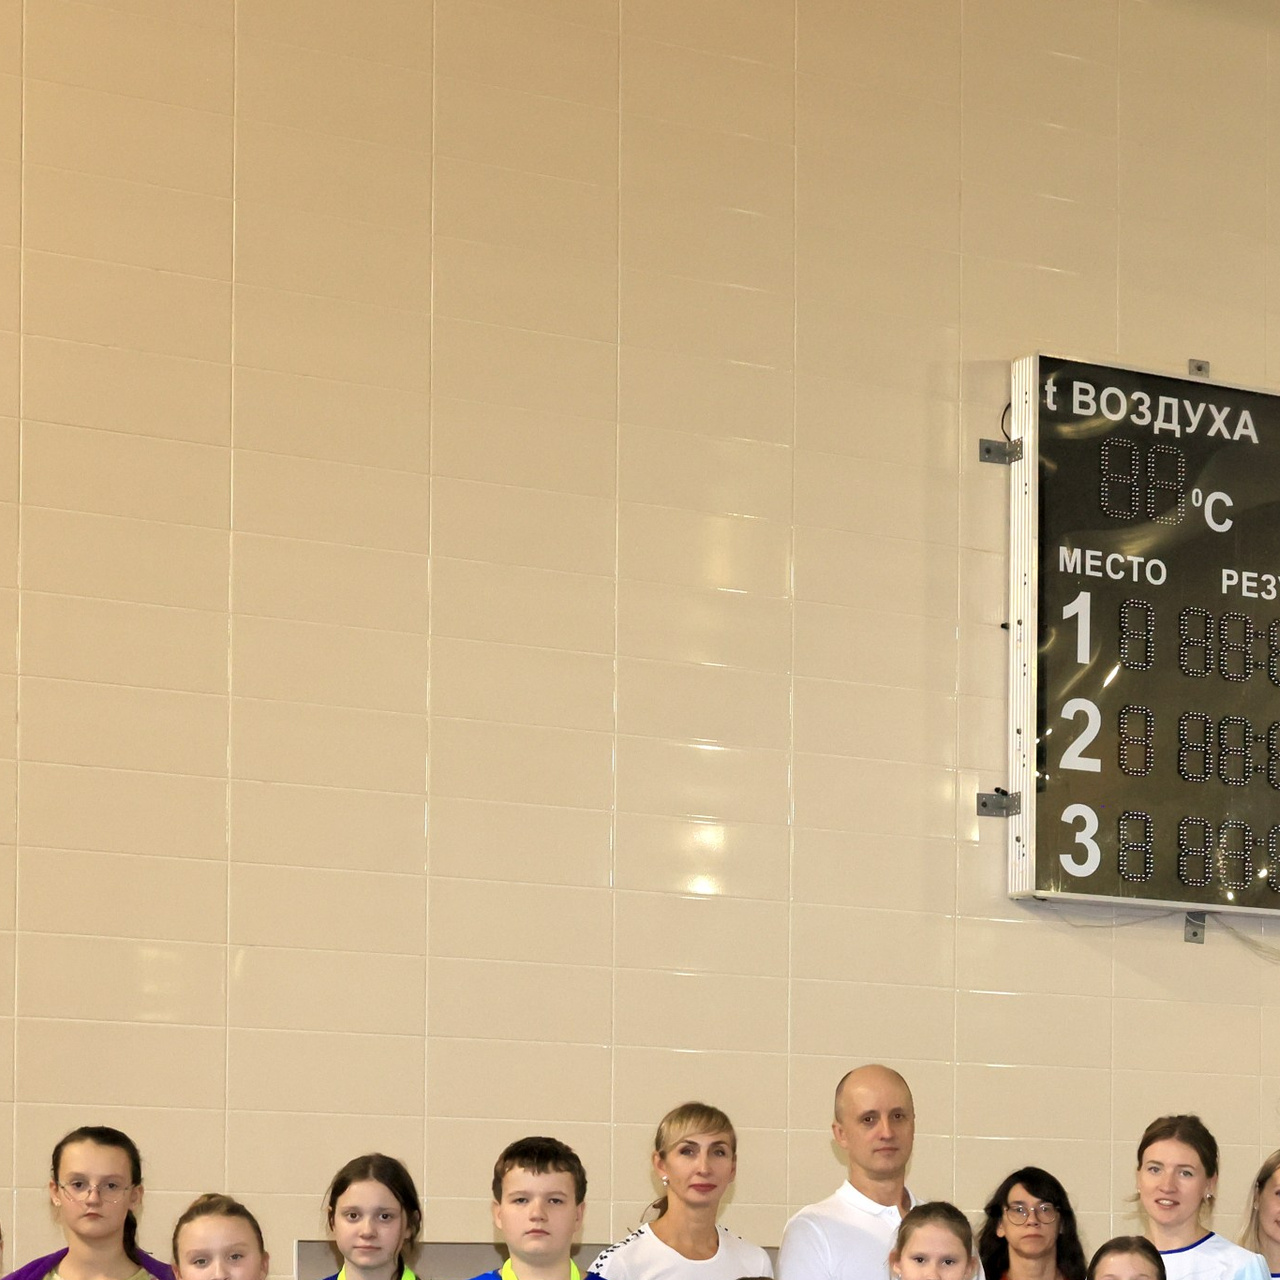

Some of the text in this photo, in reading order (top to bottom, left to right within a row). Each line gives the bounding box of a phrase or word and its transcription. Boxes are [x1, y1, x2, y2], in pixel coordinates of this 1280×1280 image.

[1045, 377, 1259, 444] t ВОЗДУХА
[1059, 546, 1167, 585] МЕСТО
[1062, 591, 1091, 664] 1
[1059, 698, 1101, 773] 2
[1059, 803, 1101, 878] 3
